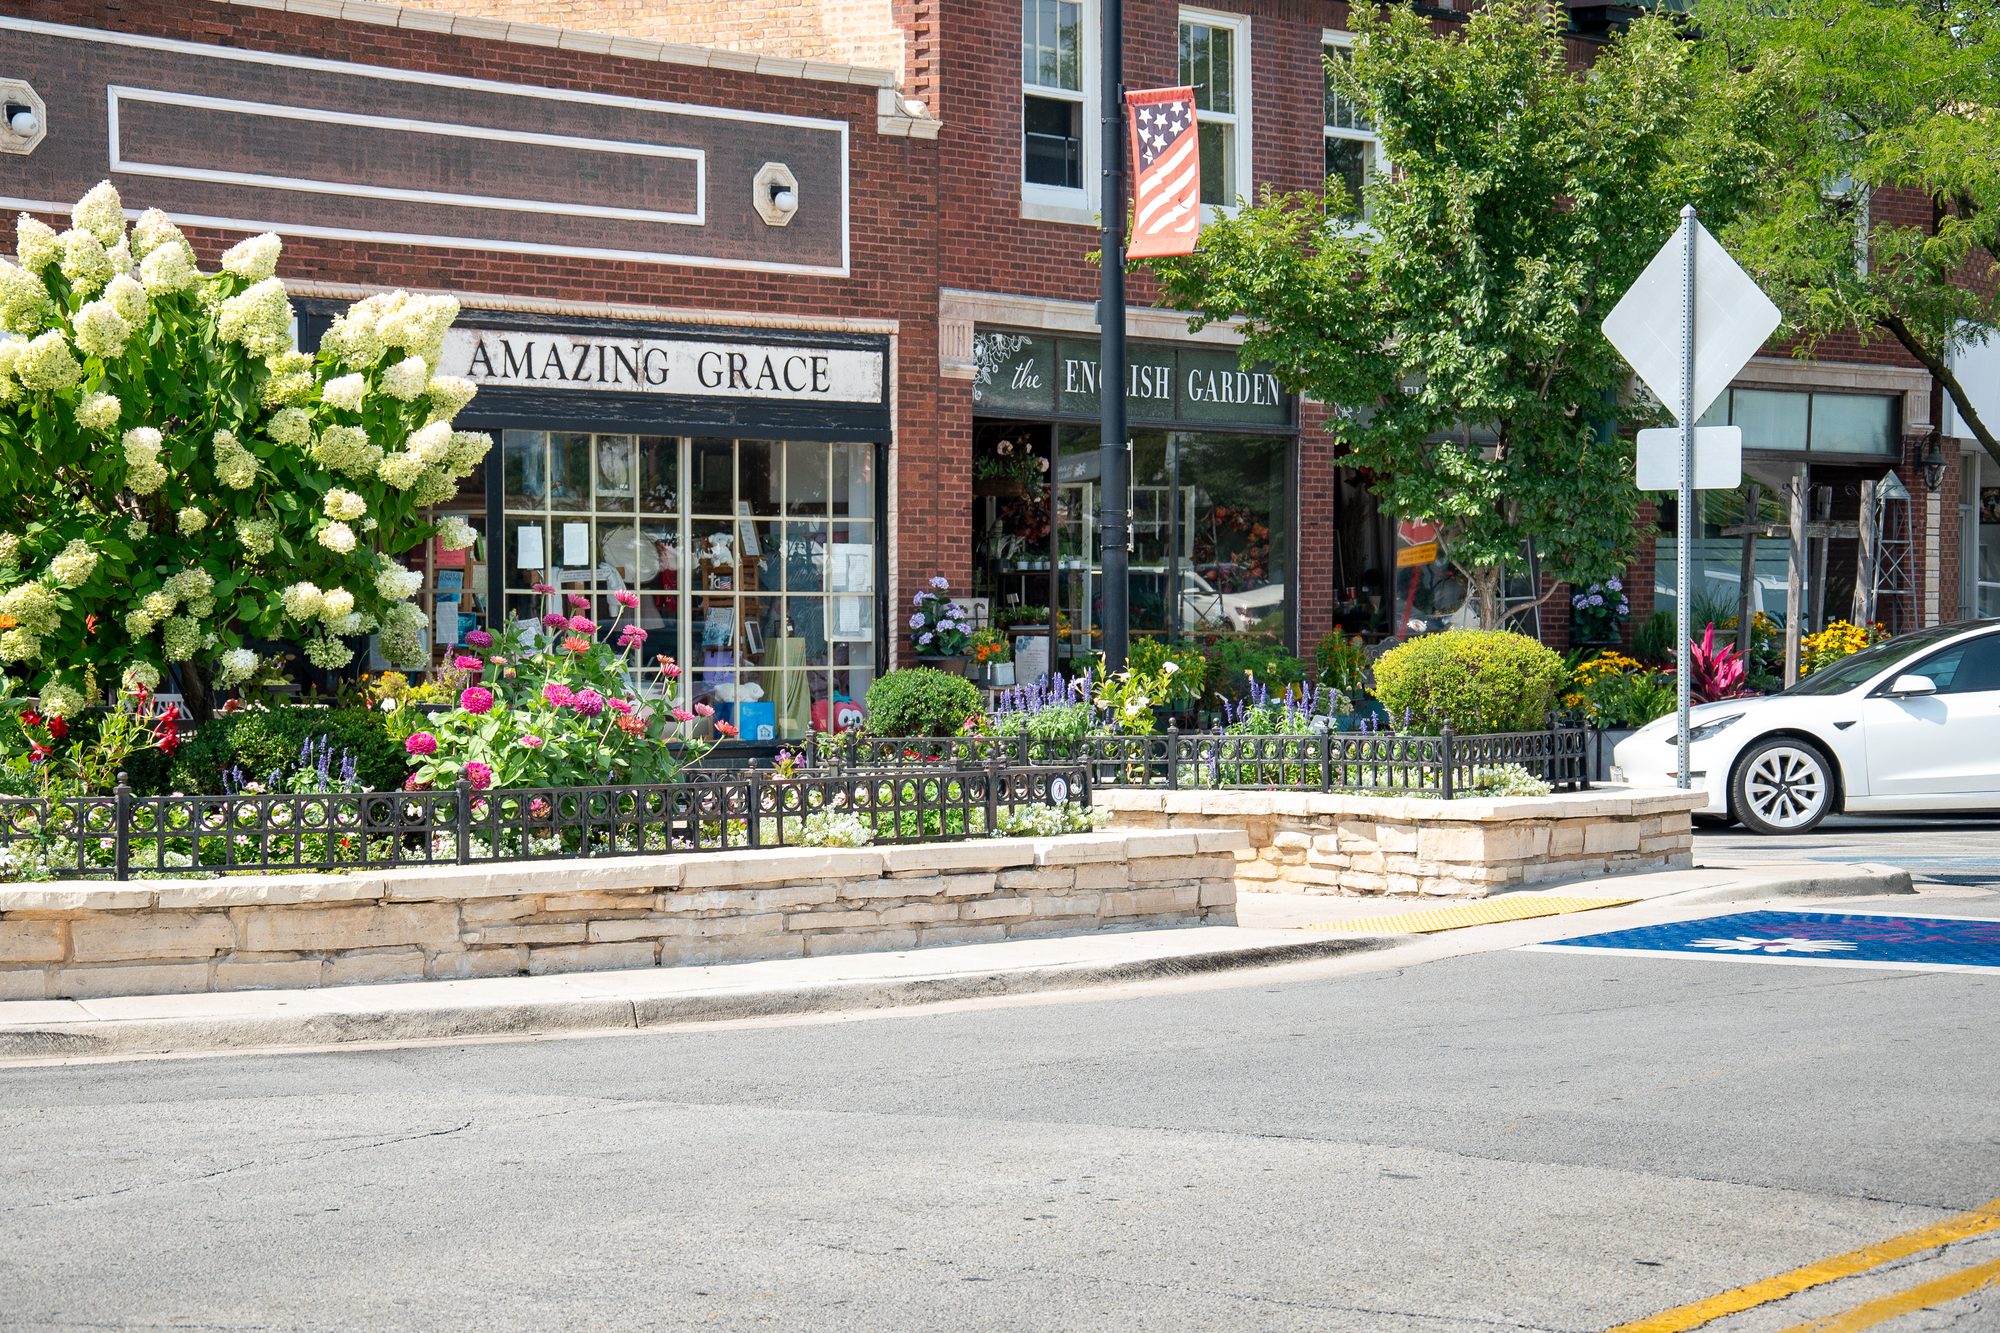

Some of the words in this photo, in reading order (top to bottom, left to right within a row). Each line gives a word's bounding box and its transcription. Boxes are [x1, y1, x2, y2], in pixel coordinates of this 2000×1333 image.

[467, 338, 670, 386] AMAZING
[698, 350, 832, 394] GRACE
[1011, 358, 1042, 390] the
[1064, 359, 1171, 400] ENISH
[1187, 368, 1280, 406] GARDEN
